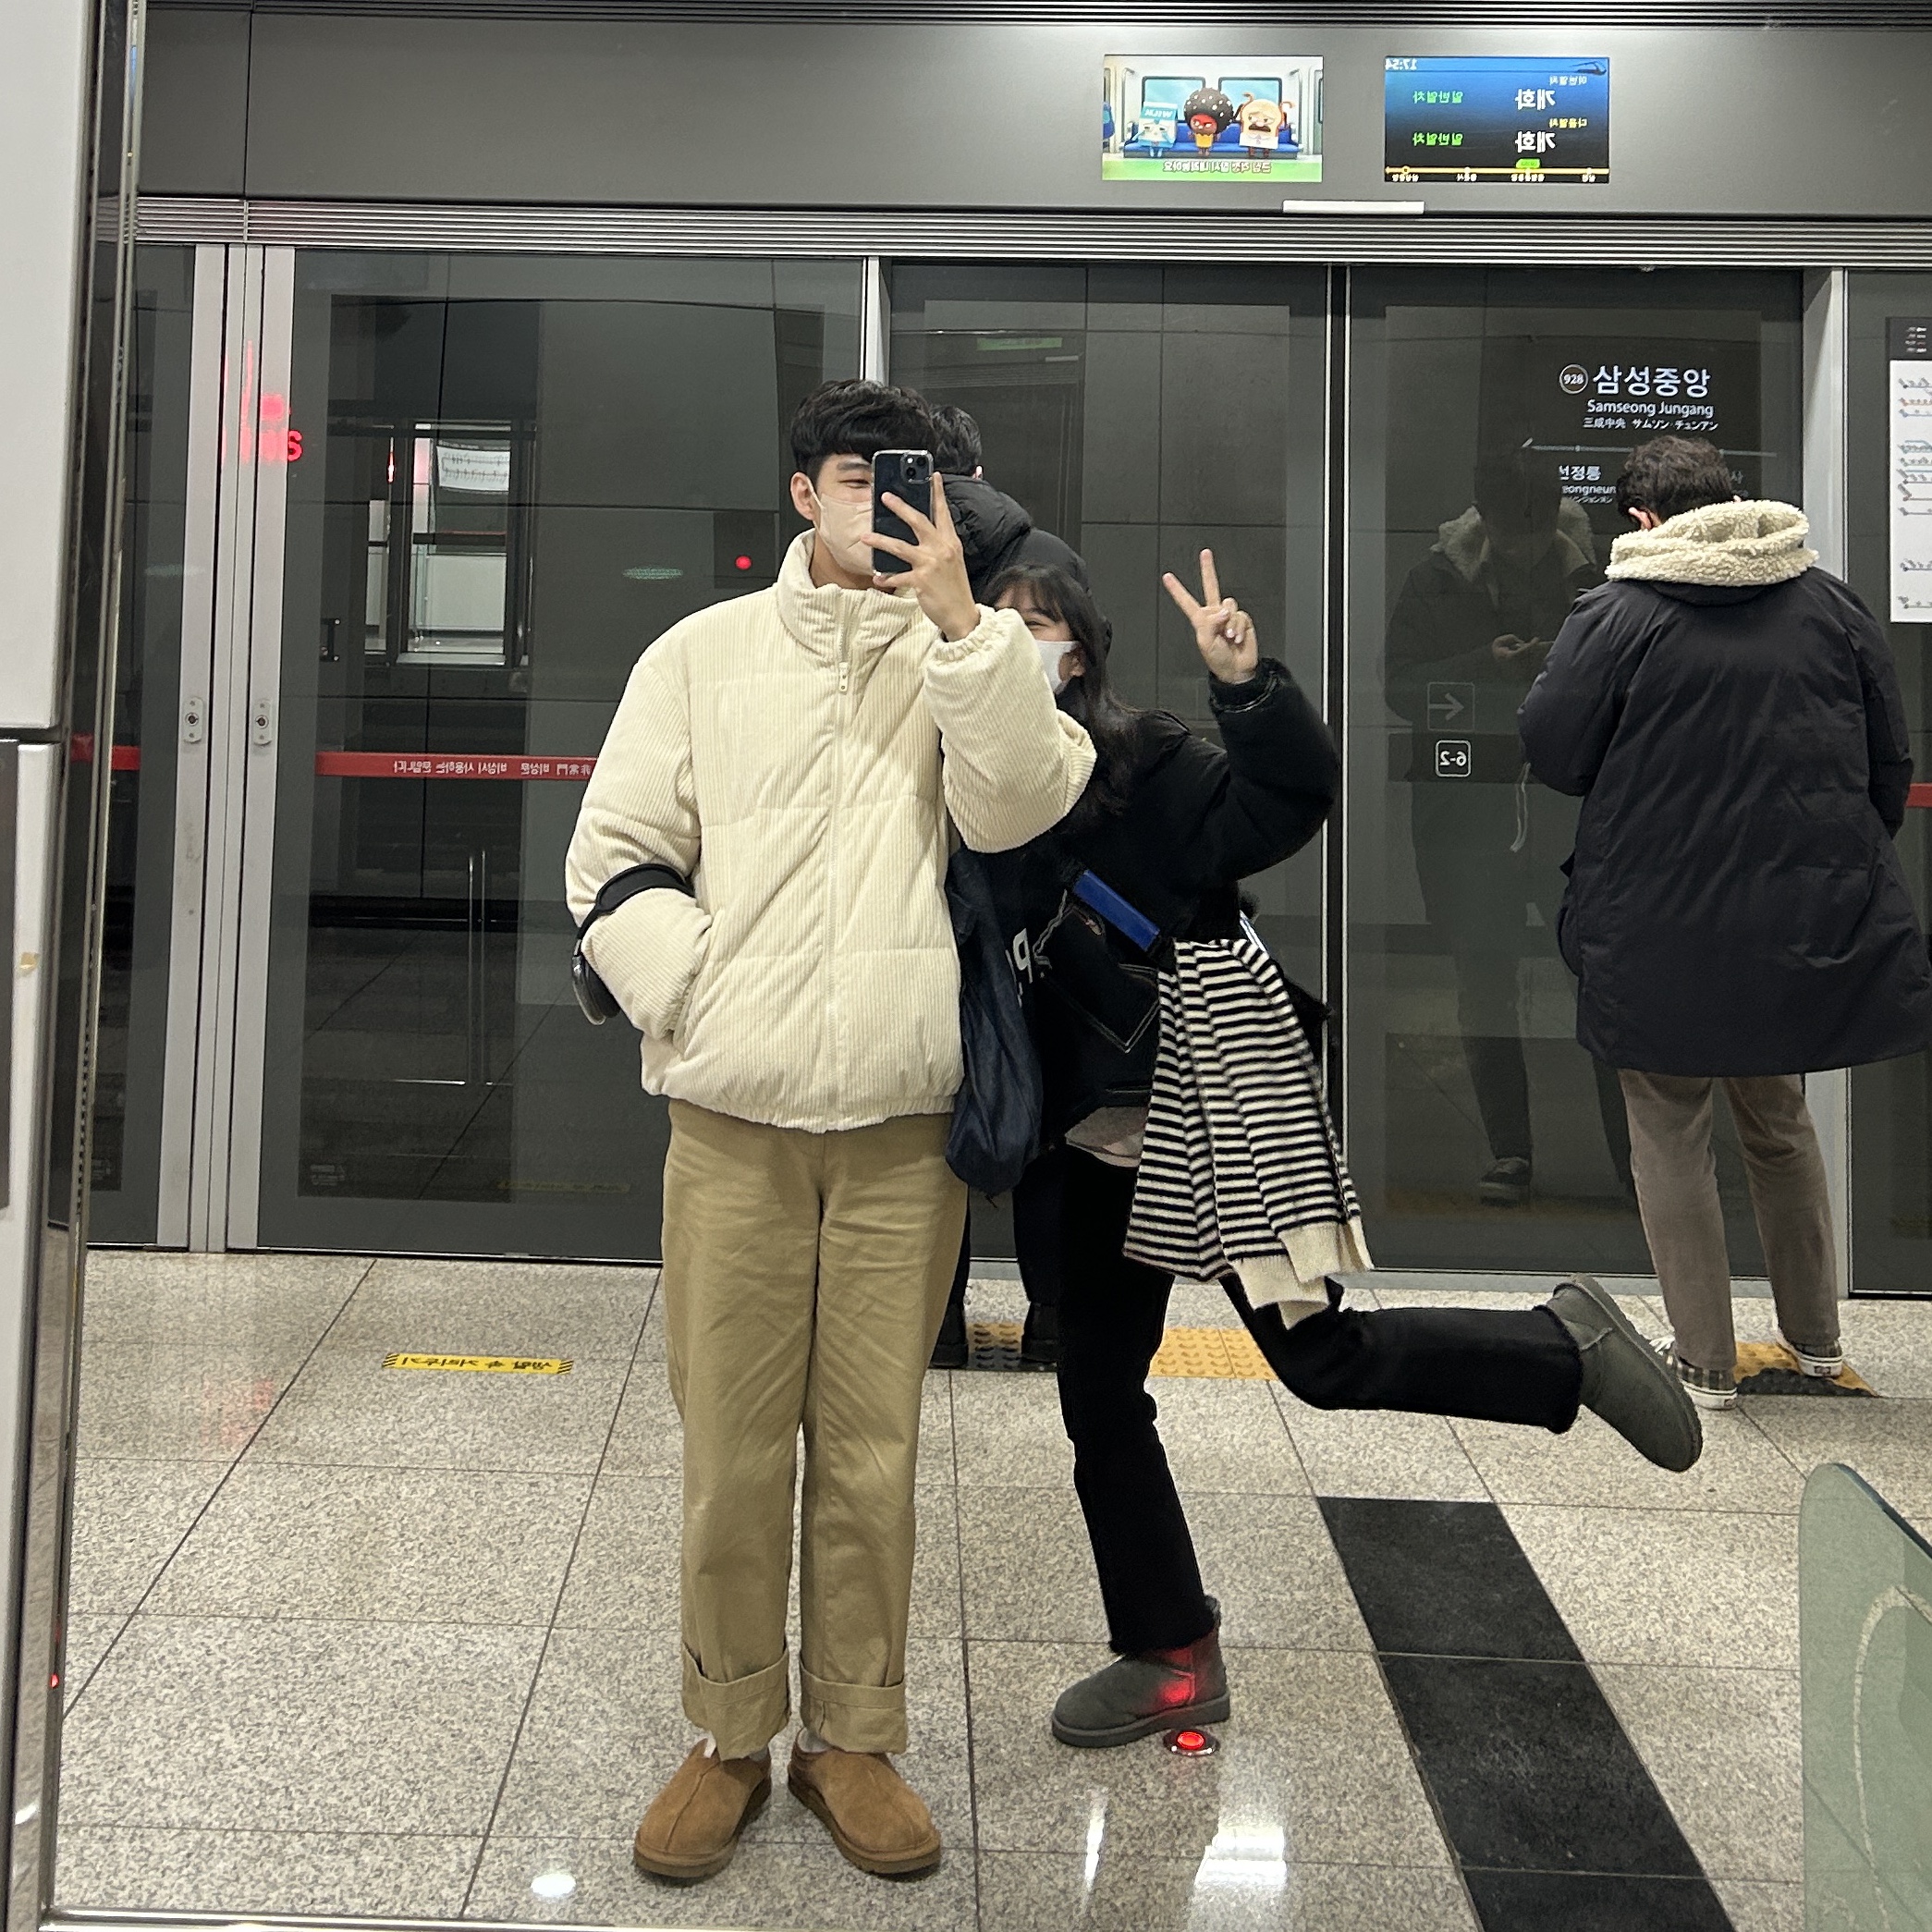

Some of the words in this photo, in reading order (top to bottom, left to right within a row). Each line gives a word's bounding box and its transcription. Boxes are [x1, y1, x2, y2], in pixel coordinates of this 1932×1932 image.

[1563, 373, 1584, 385] 928
[1593, 365, 1711, 398] 삼성중앙
[1587, 398, 1656, 417] Samseong
[1657, 401, 1714, 419] Jungang
